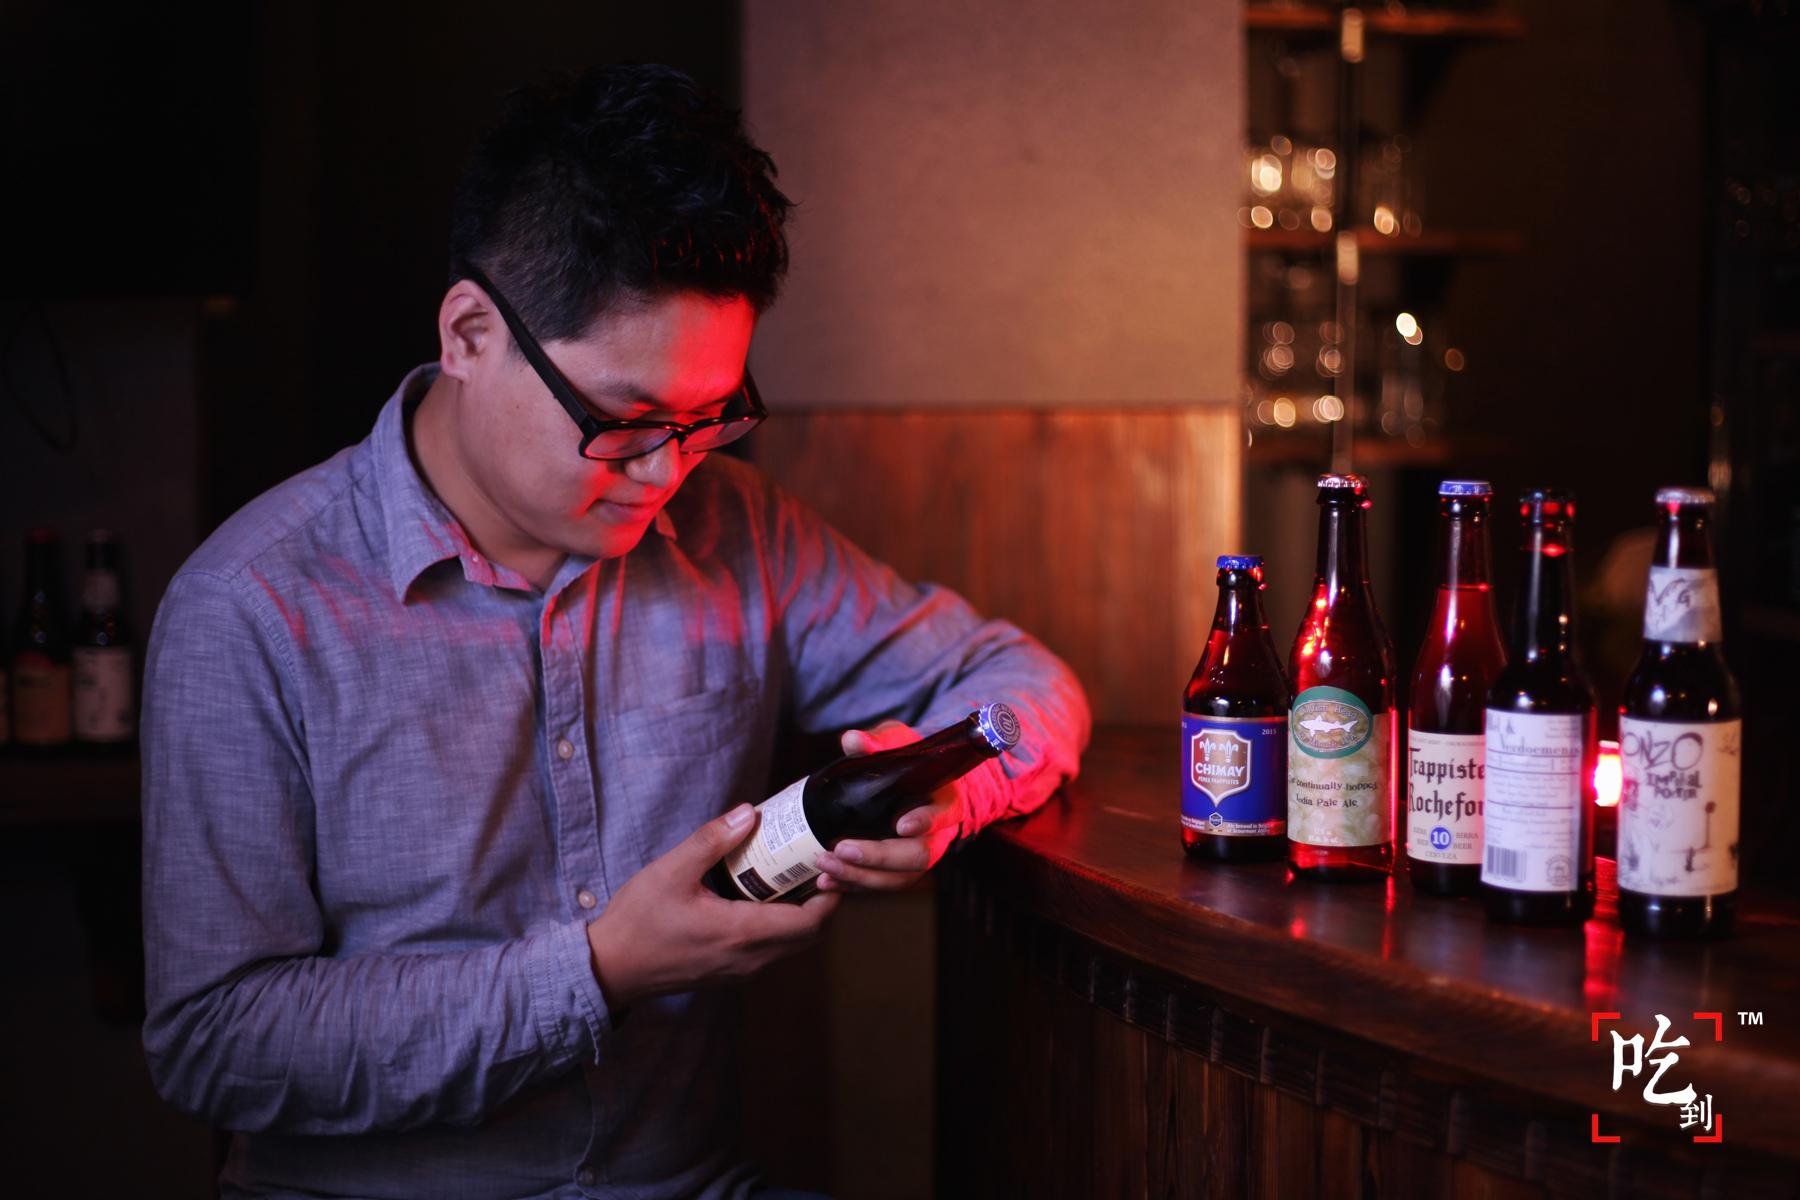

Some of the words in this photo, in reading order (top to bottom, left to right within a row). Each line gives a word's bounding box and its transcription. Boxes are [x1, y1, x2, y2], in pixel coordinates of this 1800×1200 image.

[1262, 728, 1277, 736] 2015
[1621, 730, 1704, 770] ONZO
[1195, 762, 1245, 777] CHIMAY
[1316, 798, 1338, 807] Pale
[1432, 831, 1451, 846] 10
